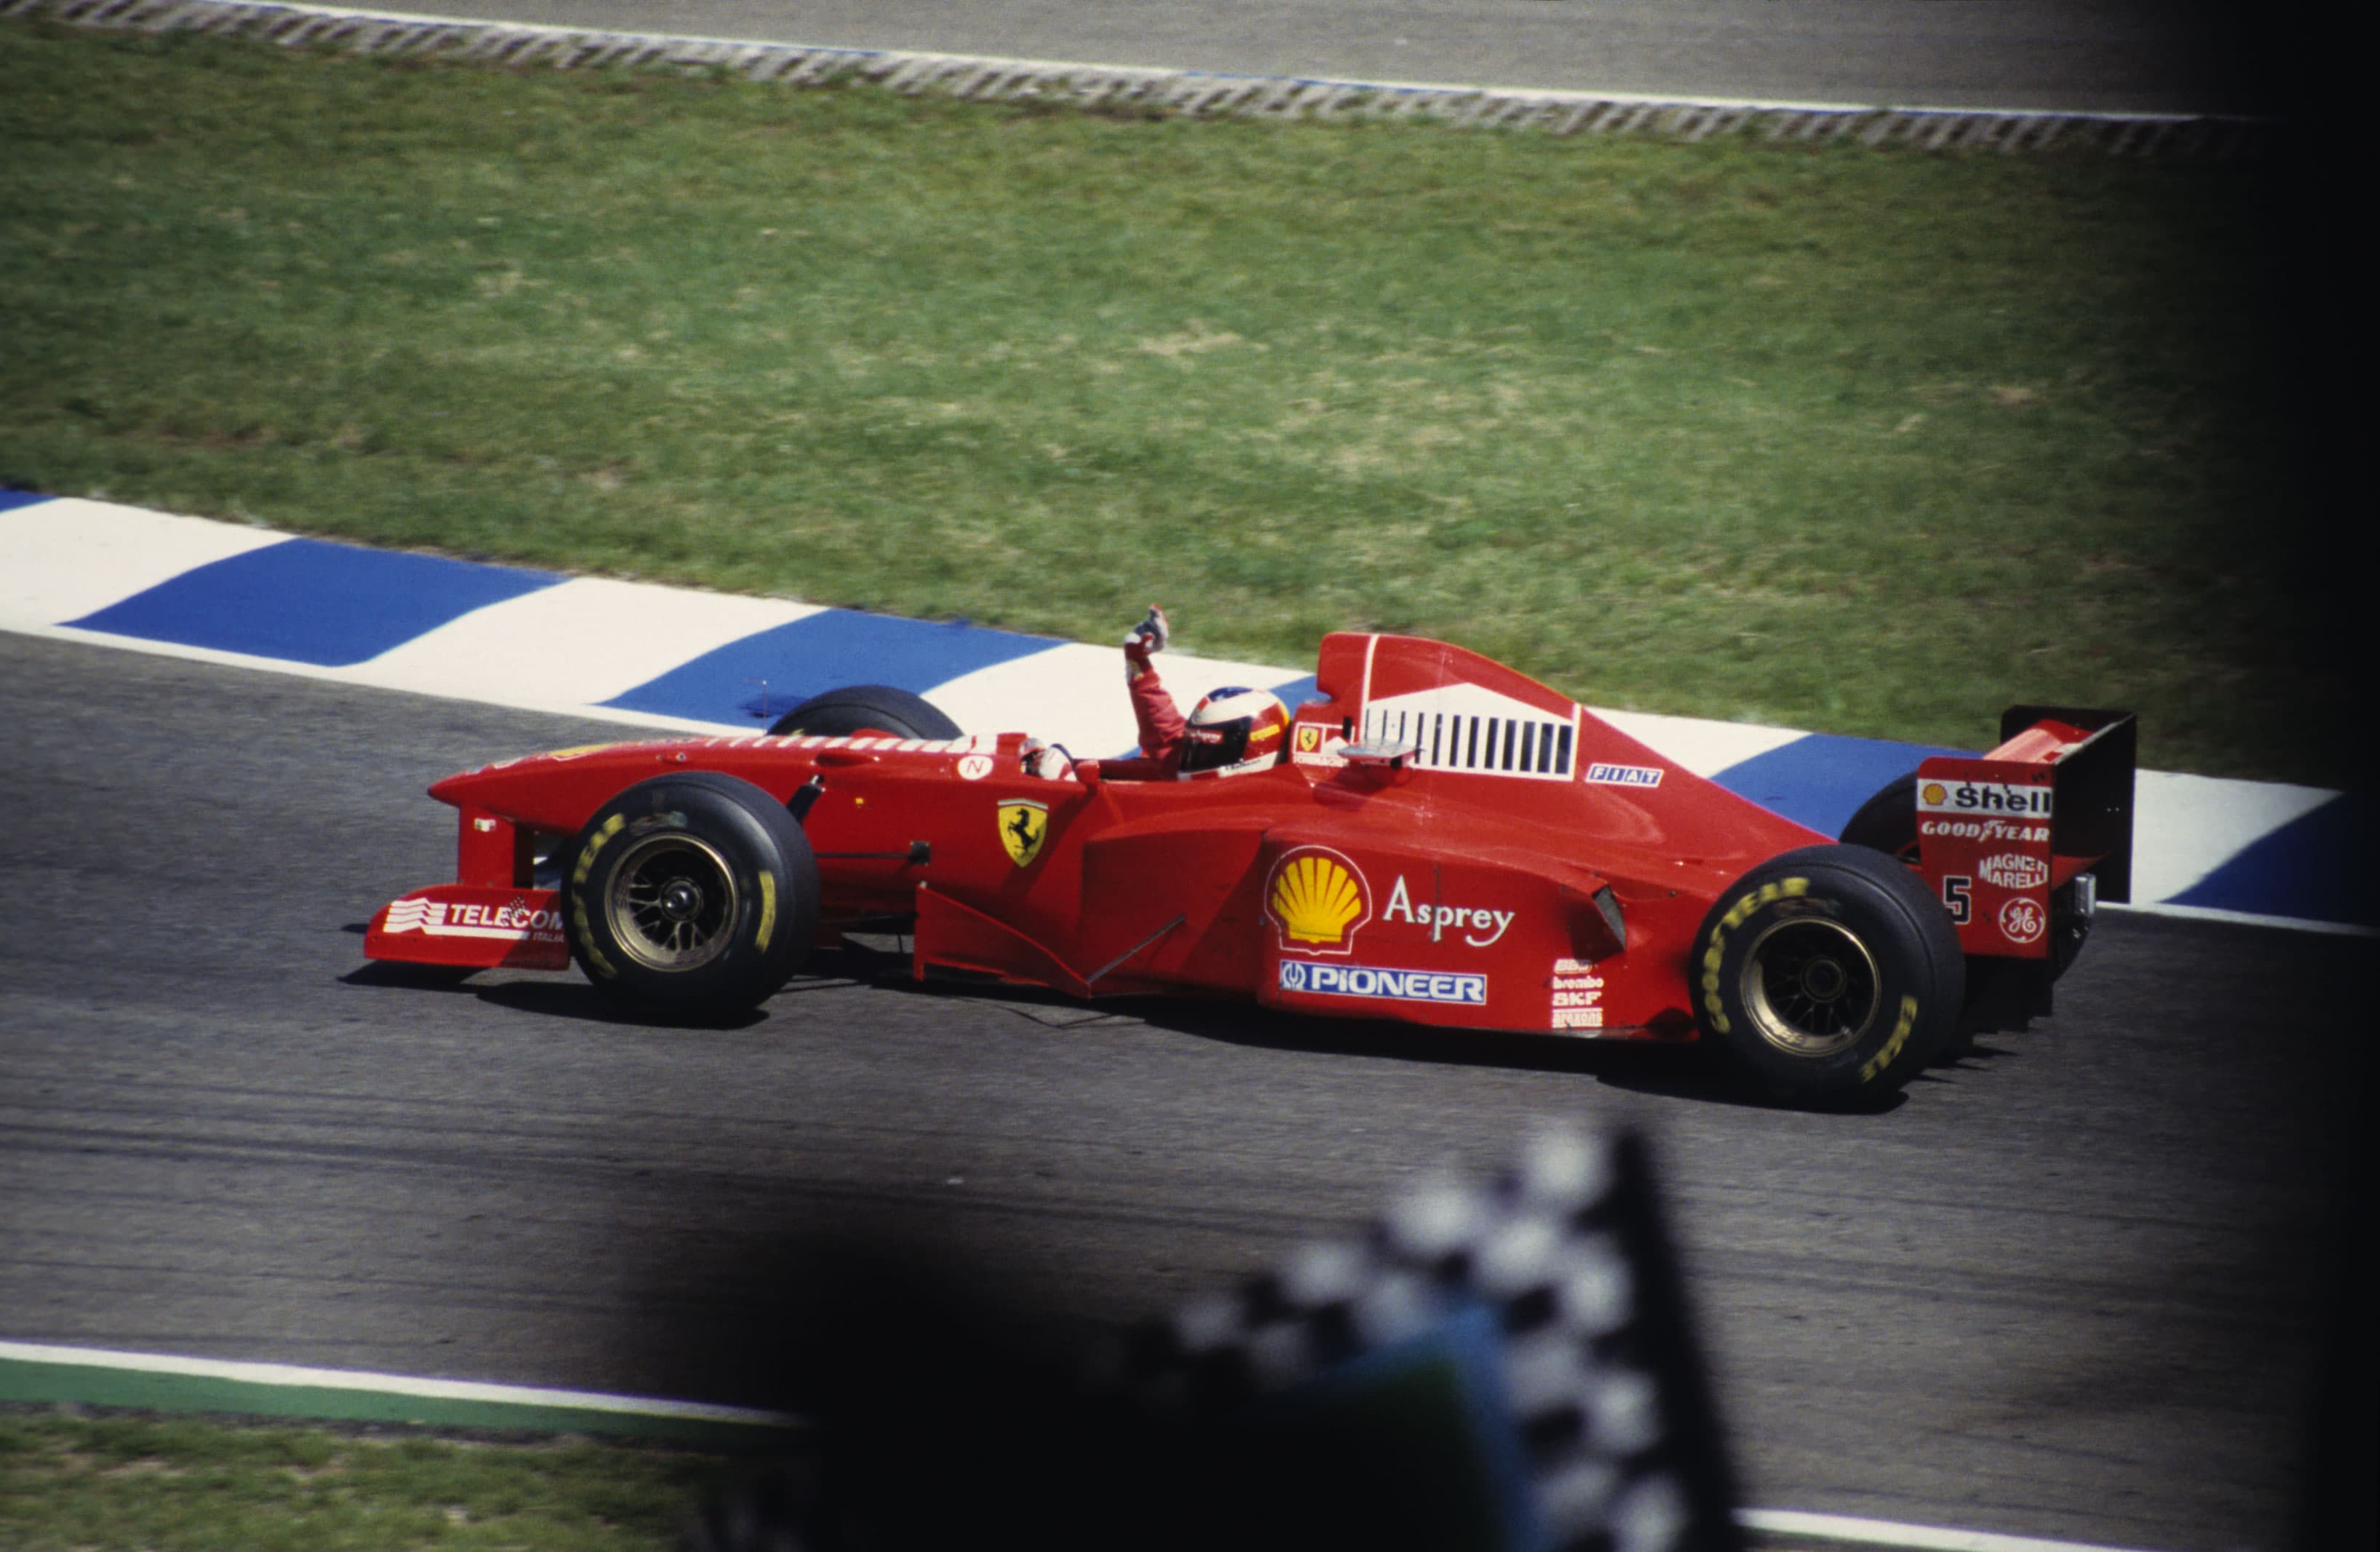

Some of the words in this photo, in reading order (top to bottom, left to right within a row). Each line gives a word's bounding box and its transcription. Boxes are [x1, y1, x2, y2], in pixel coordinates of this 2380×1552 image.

[1590, 766, 1659, 784] FIAT
[1955, 785, 2051, 813] Shell
[1921, 819, 2050, 842] GOODYEAR
[1383, 874, 1515, 947] Asprey
[1943, 876, 1971, 925] 5
[1312, 969, 1485, 1002] PIONEER
[1552, 975, 1604, 989] brembo
[1552, 991, 1602, 1006] SKF
